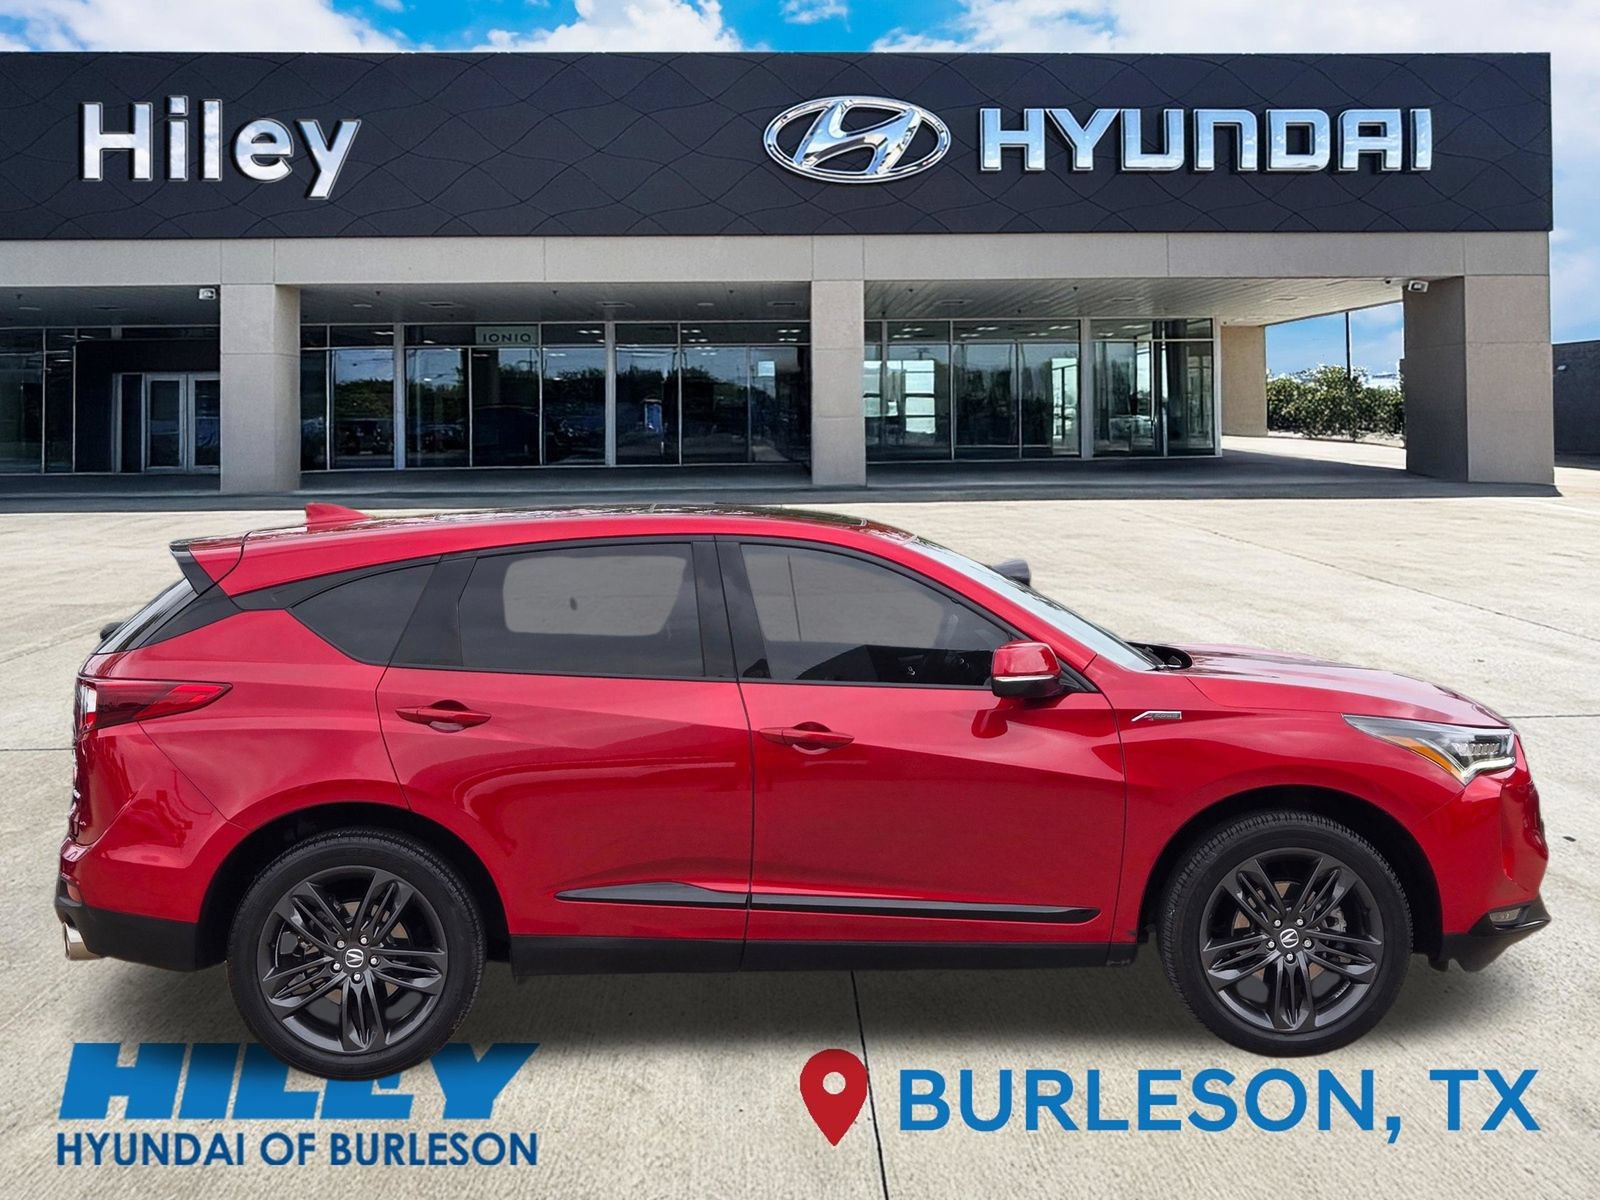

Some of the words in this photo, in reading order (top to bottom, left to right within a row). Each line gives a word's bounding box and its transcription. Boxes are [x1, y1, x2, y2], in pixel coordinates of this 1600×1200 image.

[81, 95, 362, 199] Hiley
[979, 107, 1433, 172] HYUNDAI
[482, 333, 531, 343] IONIQ
